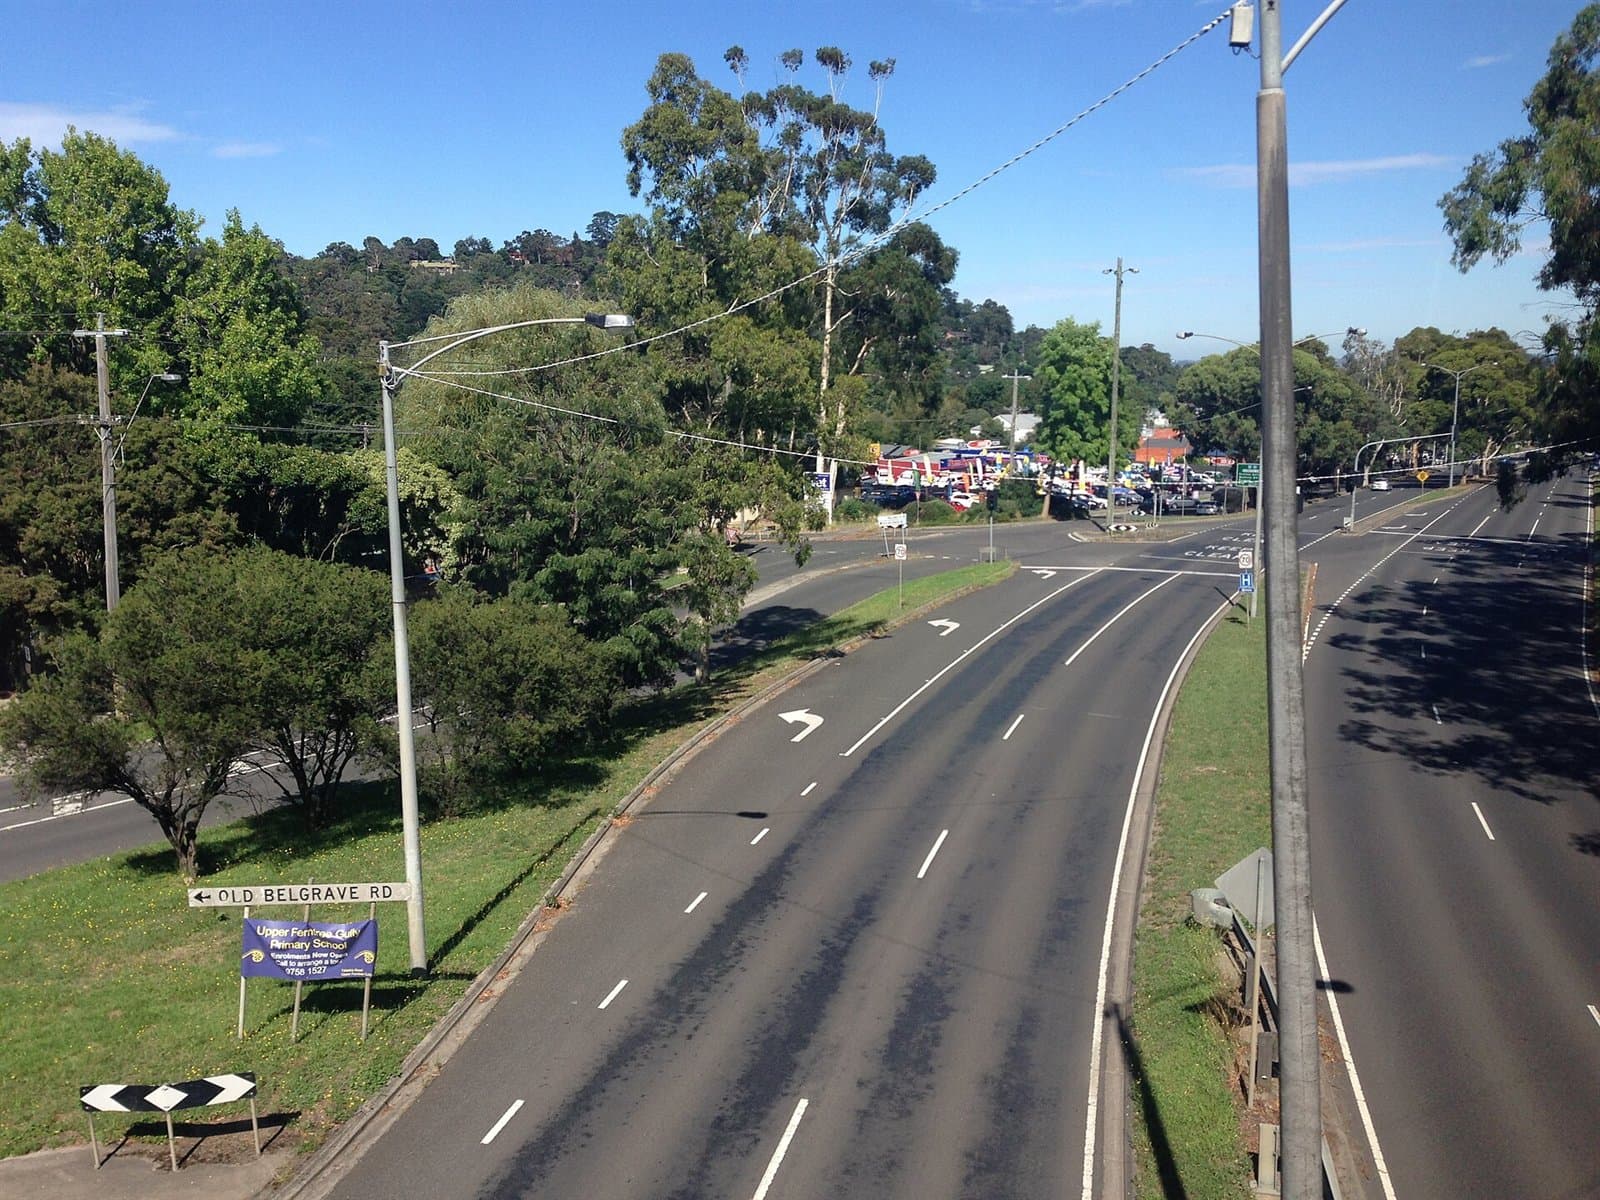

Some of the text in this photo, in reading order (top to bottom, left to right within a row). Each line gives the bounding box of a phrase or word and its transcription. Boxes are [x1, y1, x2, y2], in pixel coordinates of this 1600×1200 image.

[1205, 544, 1253, 552] KEEP
[1242, 575, 1251, 587] H
[218, 885, 393, 903] OLD BELGRAVE RD
[256, 926, 288, 938] Upper
[270, 939, 348, 951] Primary School
[308, 966, 327, 975] 1527
